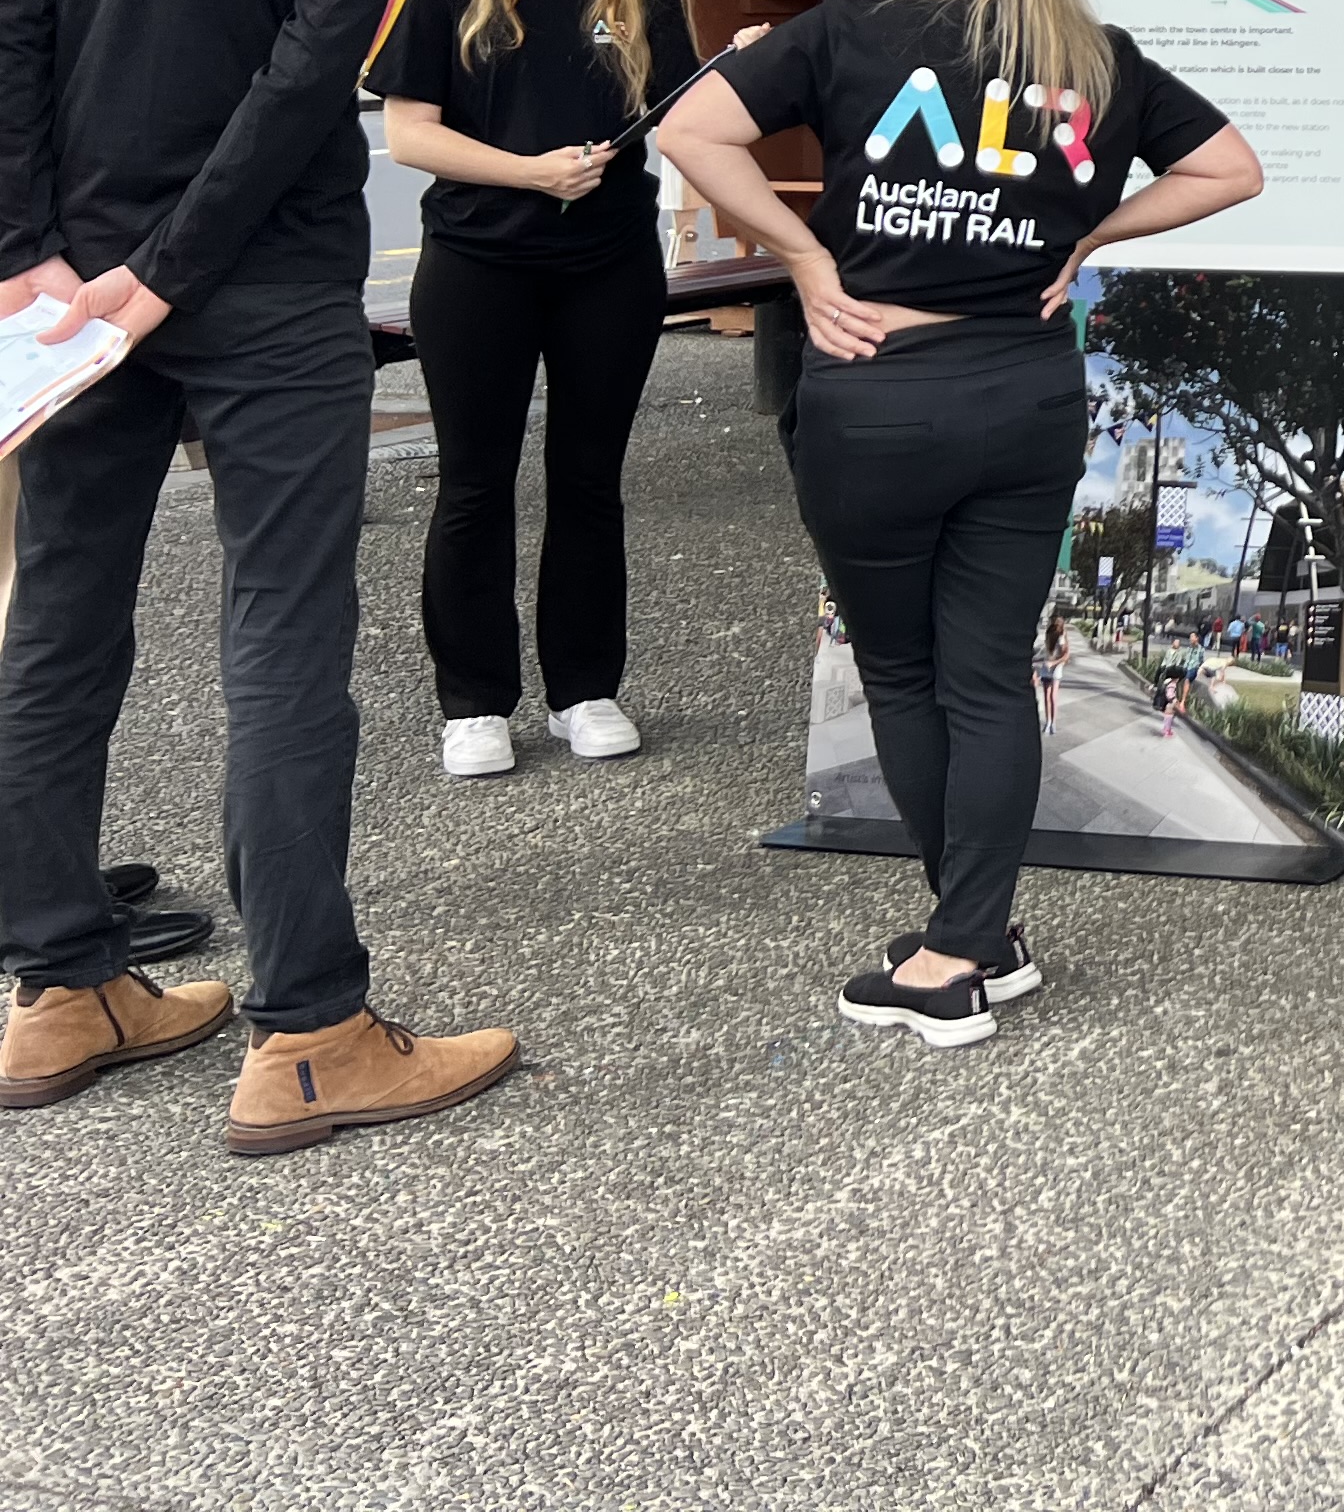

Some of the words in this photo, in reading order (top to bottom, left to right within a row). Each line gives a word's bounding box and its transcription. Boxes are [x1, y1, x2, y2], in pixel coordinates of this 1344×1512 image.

[864, 66, 1096, 184] ALR
[859, 174, 1000, 213] Auckland
[856, 201, 961, 242] LIGHT
[966, 213, 1045, 249] RAIL
